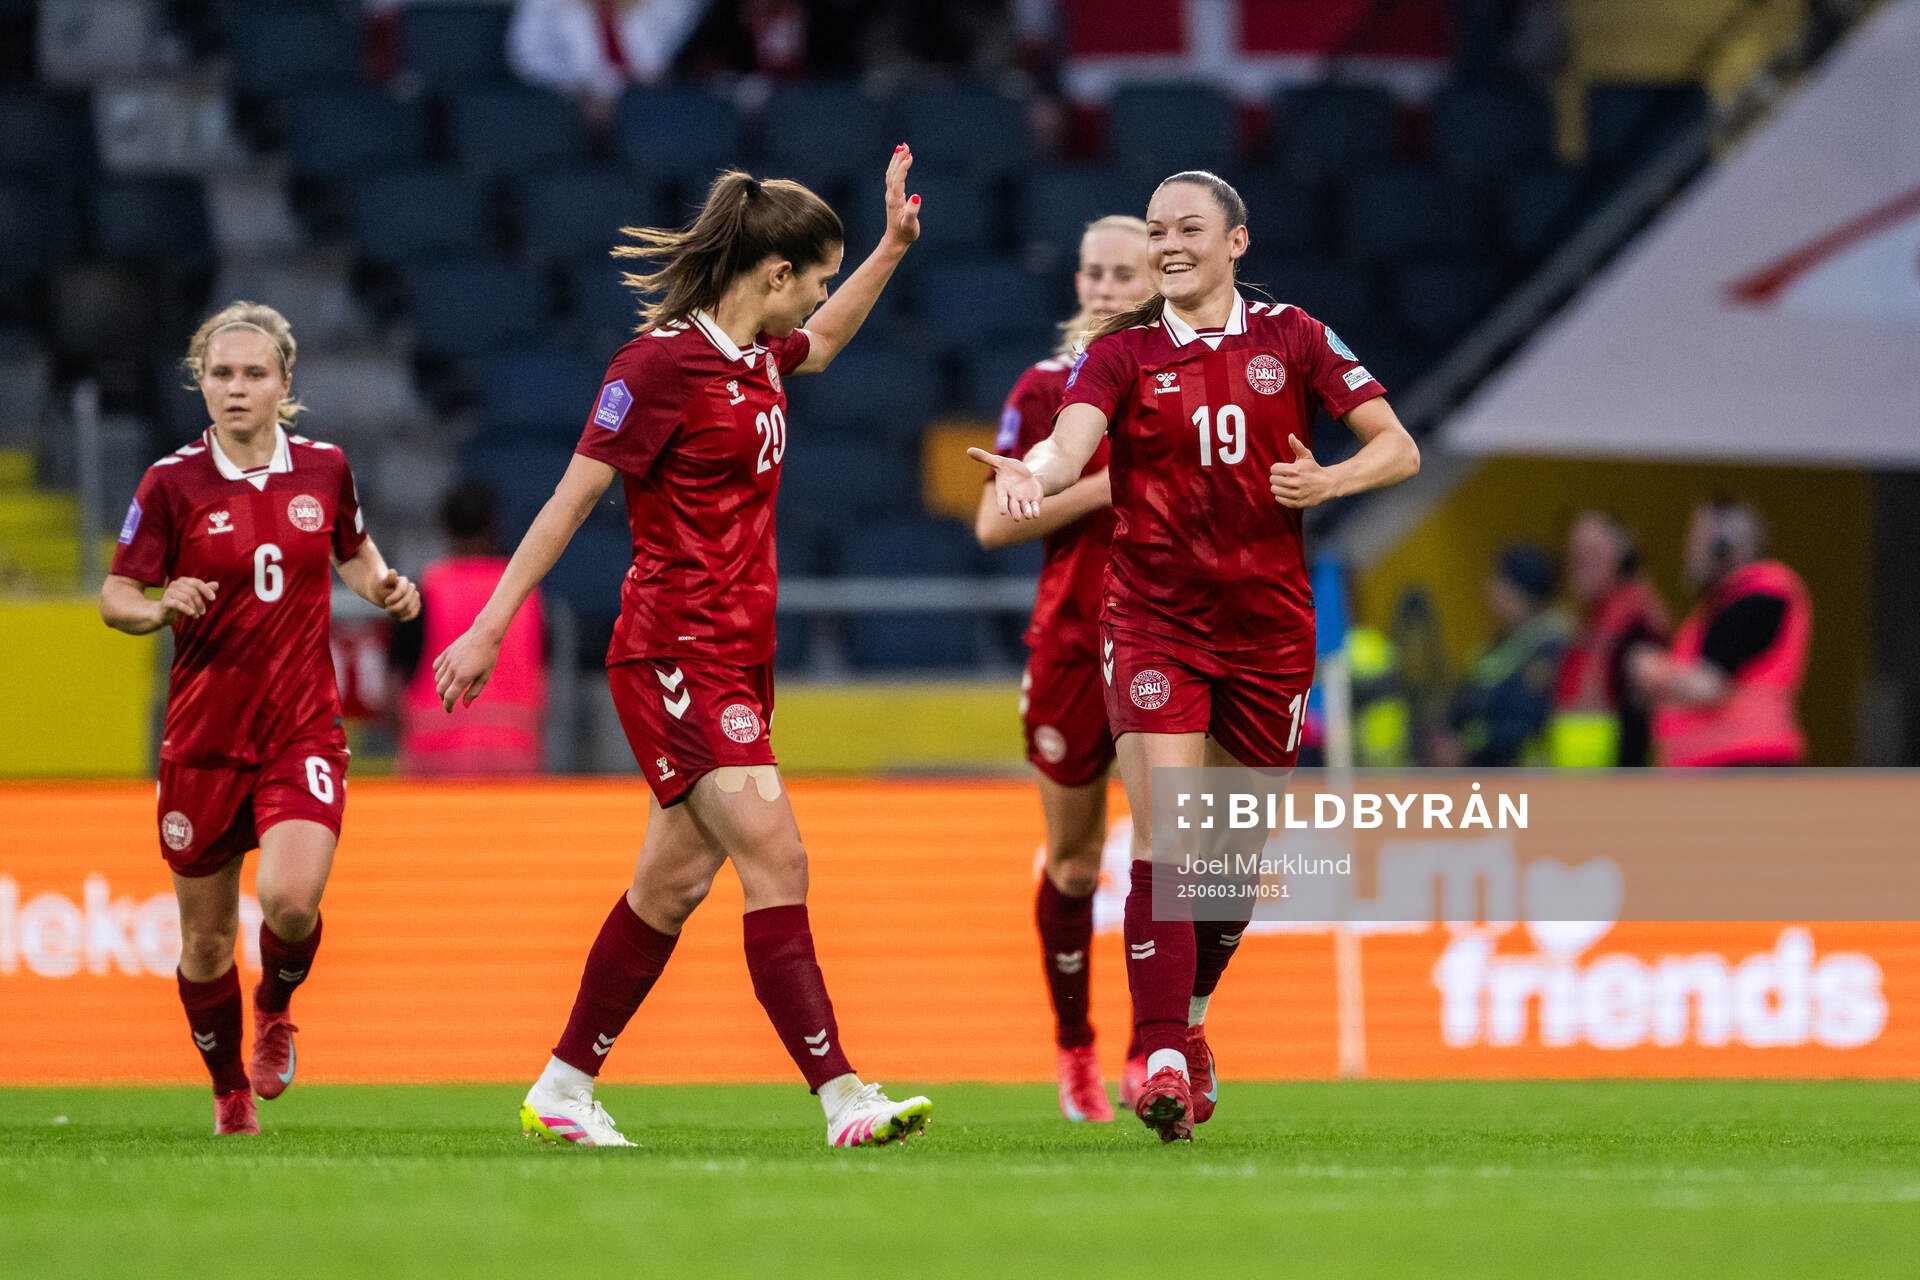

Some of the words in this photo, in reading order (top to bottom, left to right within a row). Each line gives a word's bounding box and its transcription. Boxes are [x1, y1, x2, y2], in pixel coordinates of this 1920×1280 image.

[1255, 367, 1277, 380] DBU
[1191, 404, 1246, 467] 19
[254, 543, 284, 603] 6
[1137, 682, 1161, 696] DBU
[729, 716, 752, 731] DBU
[305, 755, 335, 805] 6
[1435, 929, 1887, 1050] friends
